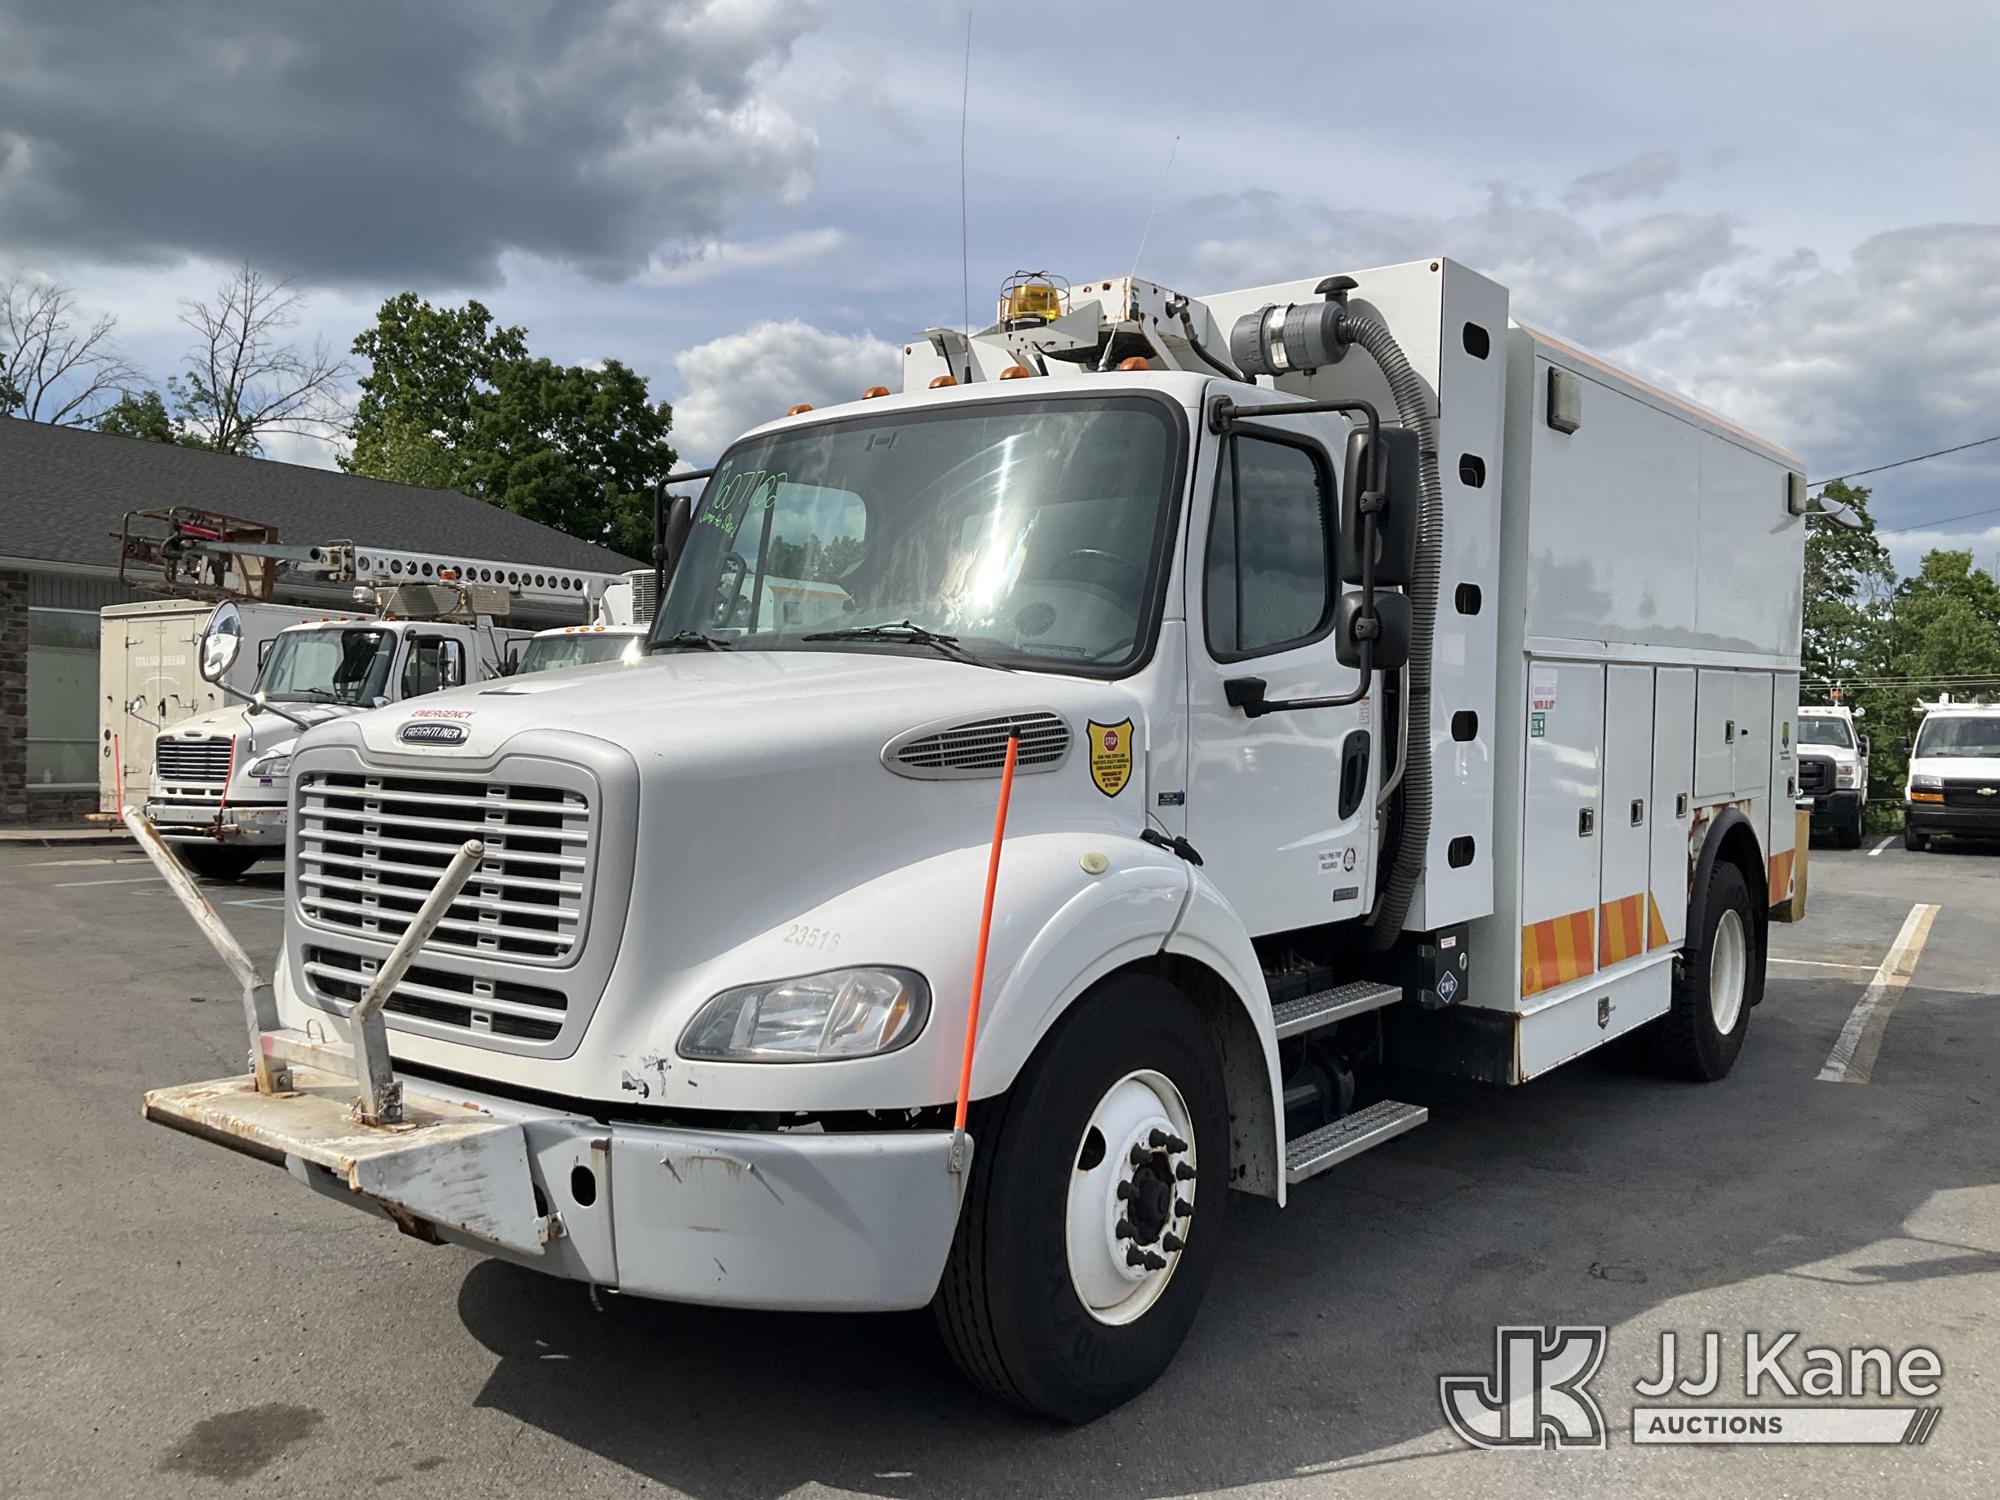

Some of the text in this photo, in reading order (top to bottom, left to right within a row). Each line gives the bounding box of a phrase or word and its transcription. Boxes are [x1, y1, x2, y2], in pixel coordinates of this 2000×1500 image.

[411, 709, 476, 719] EMERGENCY
[404, 726, 460, 739] FREIGHTLINER
[1104, 736, 1117, 746] STOP
[1441, 980, 1454, 994] CNG
